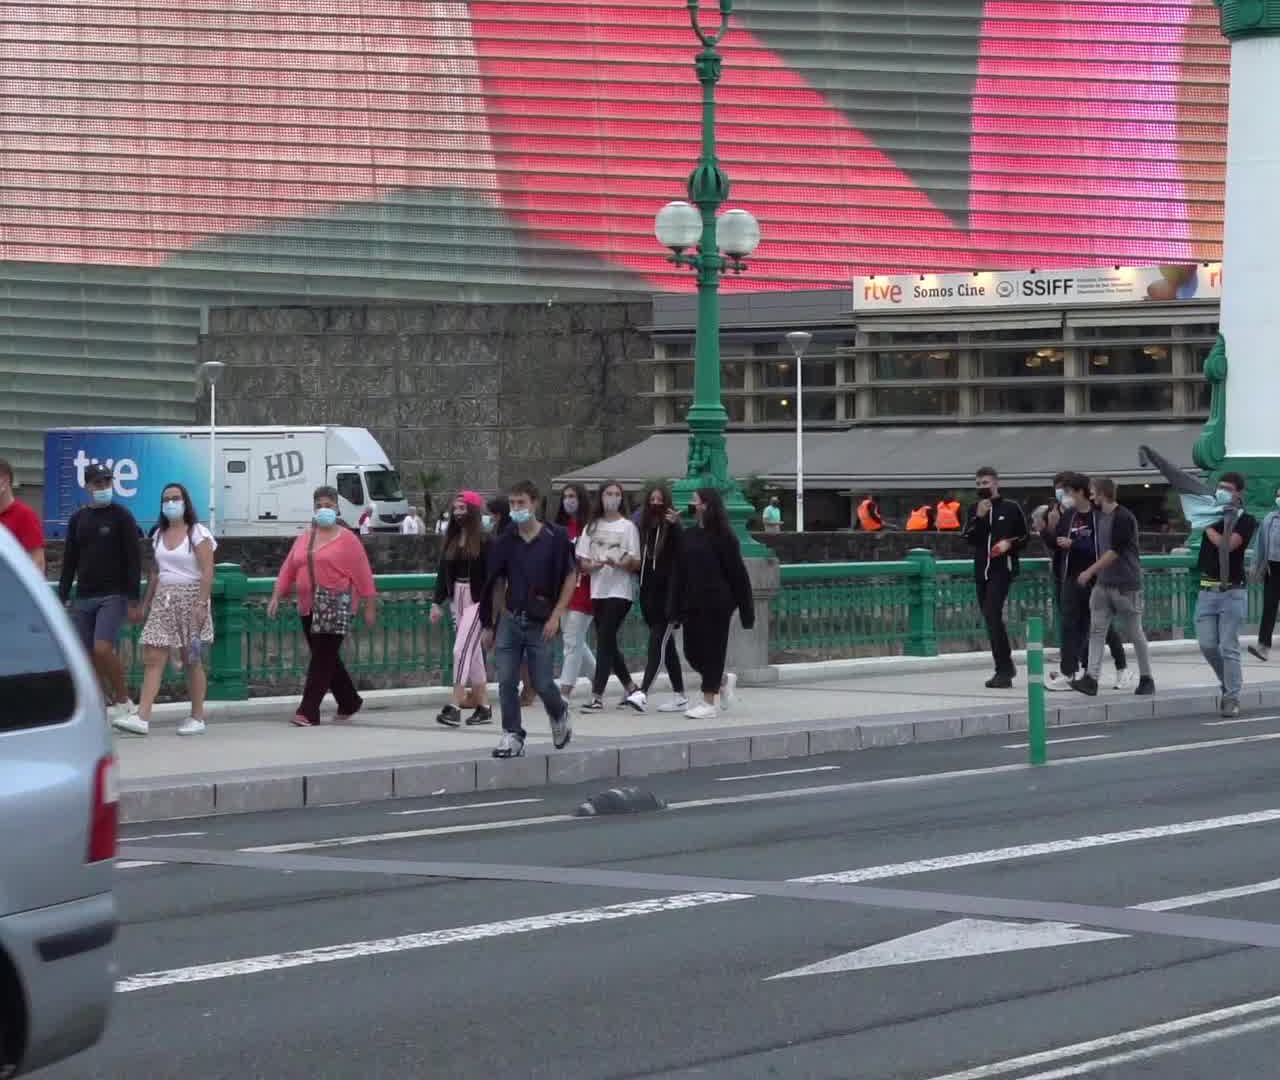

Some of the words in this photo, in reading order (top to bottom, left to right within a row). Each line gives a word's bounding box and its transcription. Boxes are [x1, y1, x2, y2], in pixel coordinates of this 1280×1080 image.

[864, 283, 902, 303] rtve
[913, 285, 953, 298] Somos
[958, 283, 985, 297] Cine
[1022, 278, 1074, 296] SSIFF
[264, 450, 304, 481] HD
